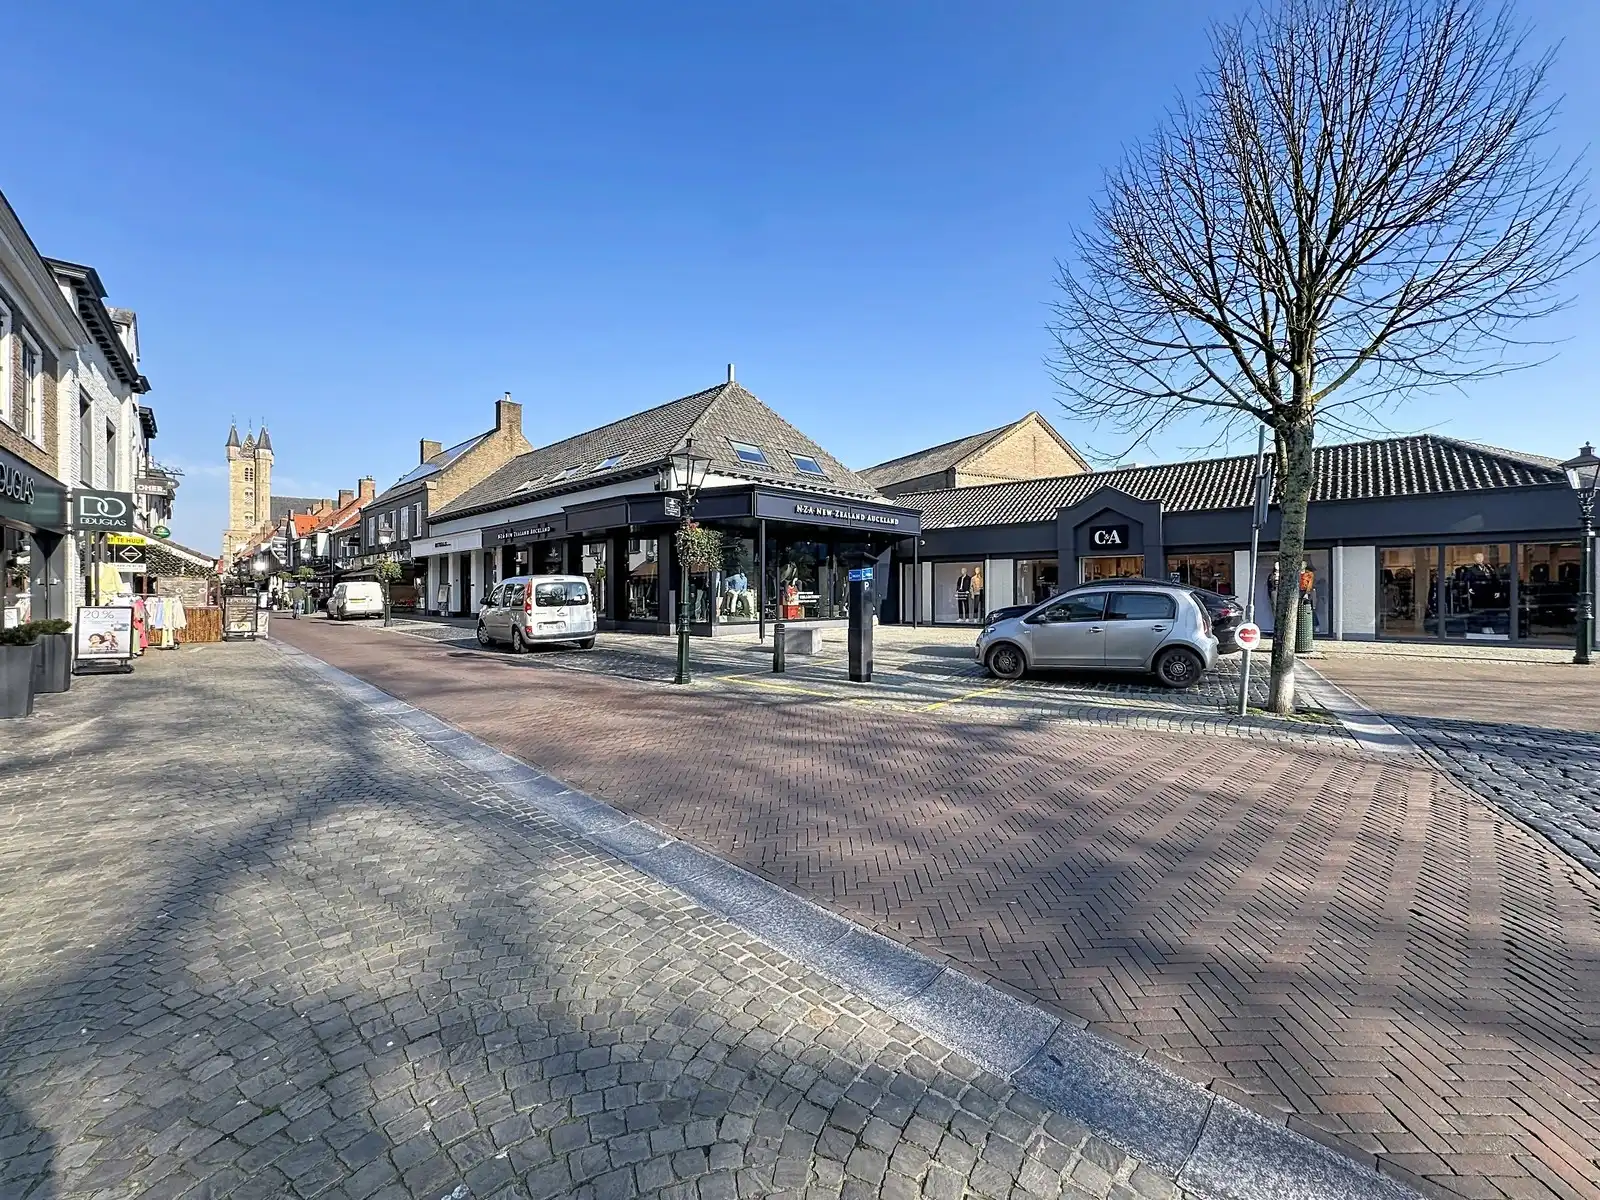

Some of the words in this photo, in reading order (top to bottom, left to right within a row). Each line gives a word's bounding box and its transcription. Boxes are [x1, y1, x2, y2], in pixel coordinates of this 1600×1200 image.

[80, 518, 127, 526] DOUGLAS
[816, 508, 832, 516] NEW
[835, 510, 866, 520] ZEALAND
[867, 514, 899, 525] AUCKLAND
[1094, 530, 1122, 544] C&A
[864, 581, 870, 590] P
